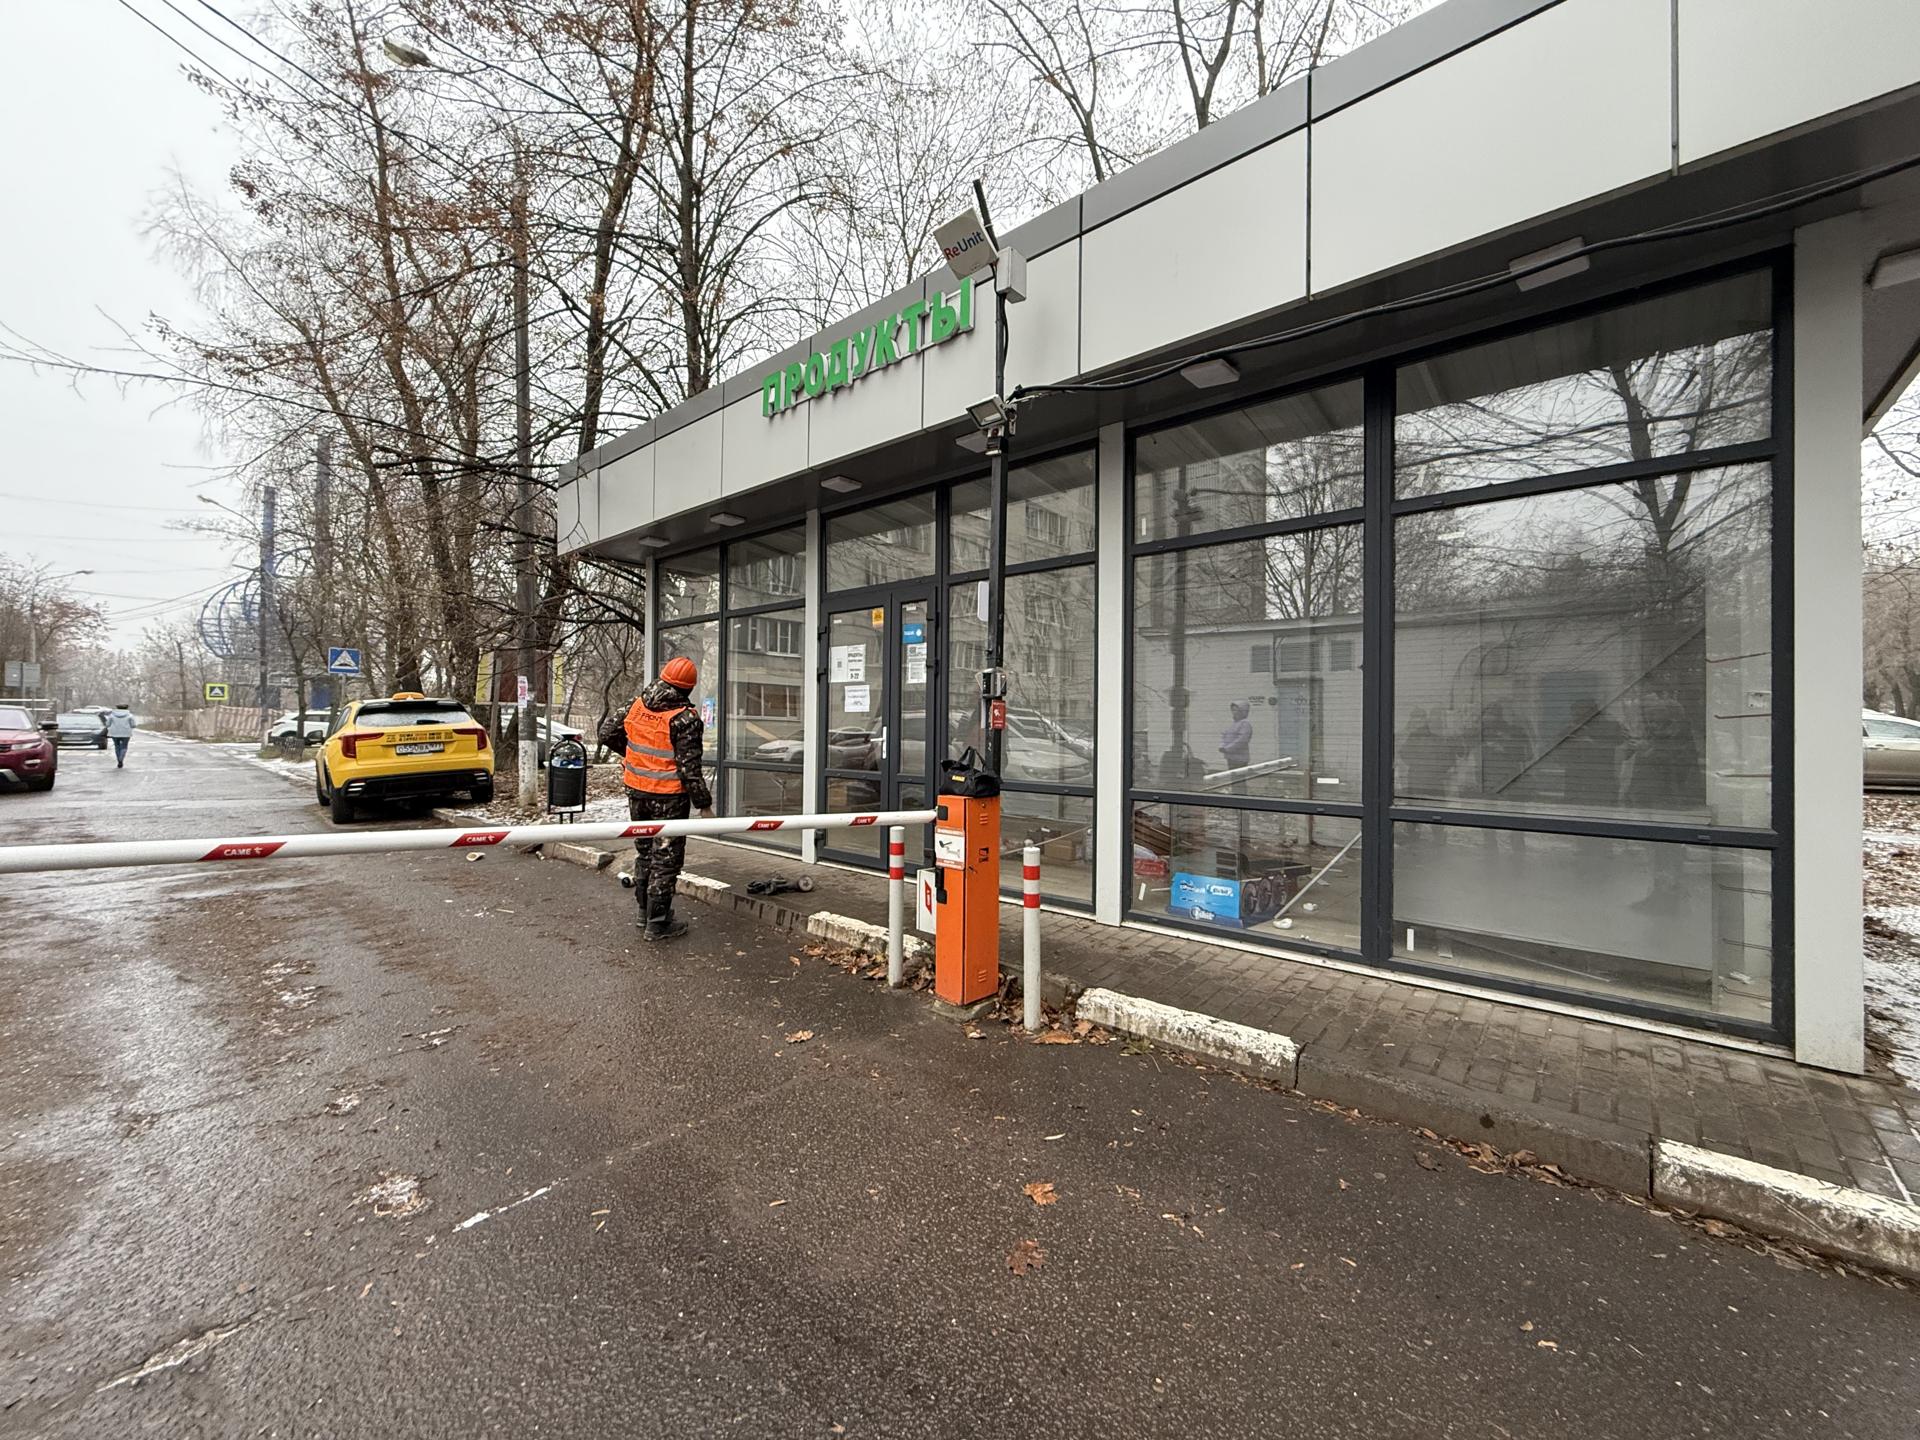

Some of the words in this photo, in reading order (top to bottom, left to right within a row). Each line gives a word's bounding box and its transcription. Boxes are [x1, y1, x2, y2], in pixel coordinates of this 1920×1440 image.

[943, 231, 984, 260] ReUnit
[762, 276, 975, 417] ПРОДУКТЫ
[224, 848, 252, 856] CAME
